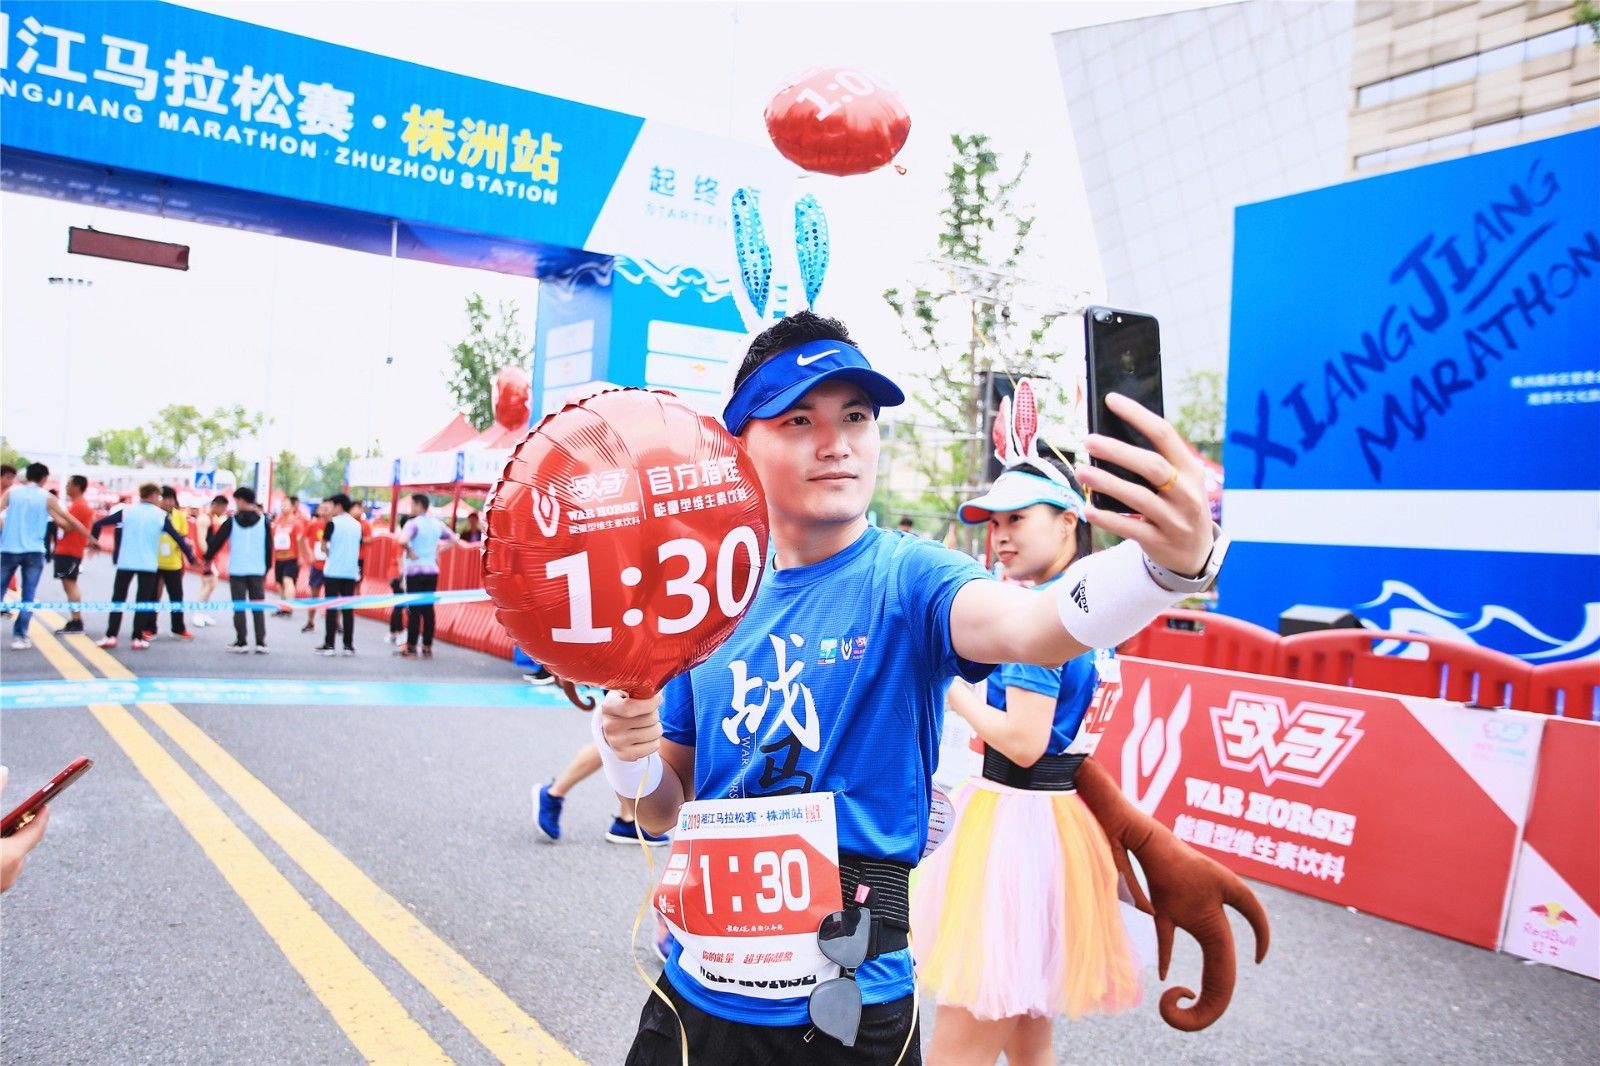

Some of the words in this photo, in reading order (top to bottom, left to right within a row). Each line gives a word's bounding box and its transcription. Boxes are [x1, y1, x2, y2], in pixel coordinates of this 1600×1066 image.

[0, 12, 563, 185] 江马拉松赛·株洲站
[158, 110, 317, 158] MARATHON
[334, 146, 455, 185] ZHUZHOU
[460, 171, 558, 205] STATION
[1356, 231, 1600, 484] MARATHON
[567, 508, 595, 521] WAR
[597, 501, 640, 517] HORSE
[544, 524, 762, 645] 1:30
[729, 768, 746, 799] HORS
[741, 736, 751, 766] WAR
[687, 813, 701, 830] 2019
[1184, 776, 1244, 818] WAR
[1244, 791, 1357, 846] HORSE
[700, 848, 811, 915] 1:30
[1173, 813, 1345, 885] 能量型维生素饮料
